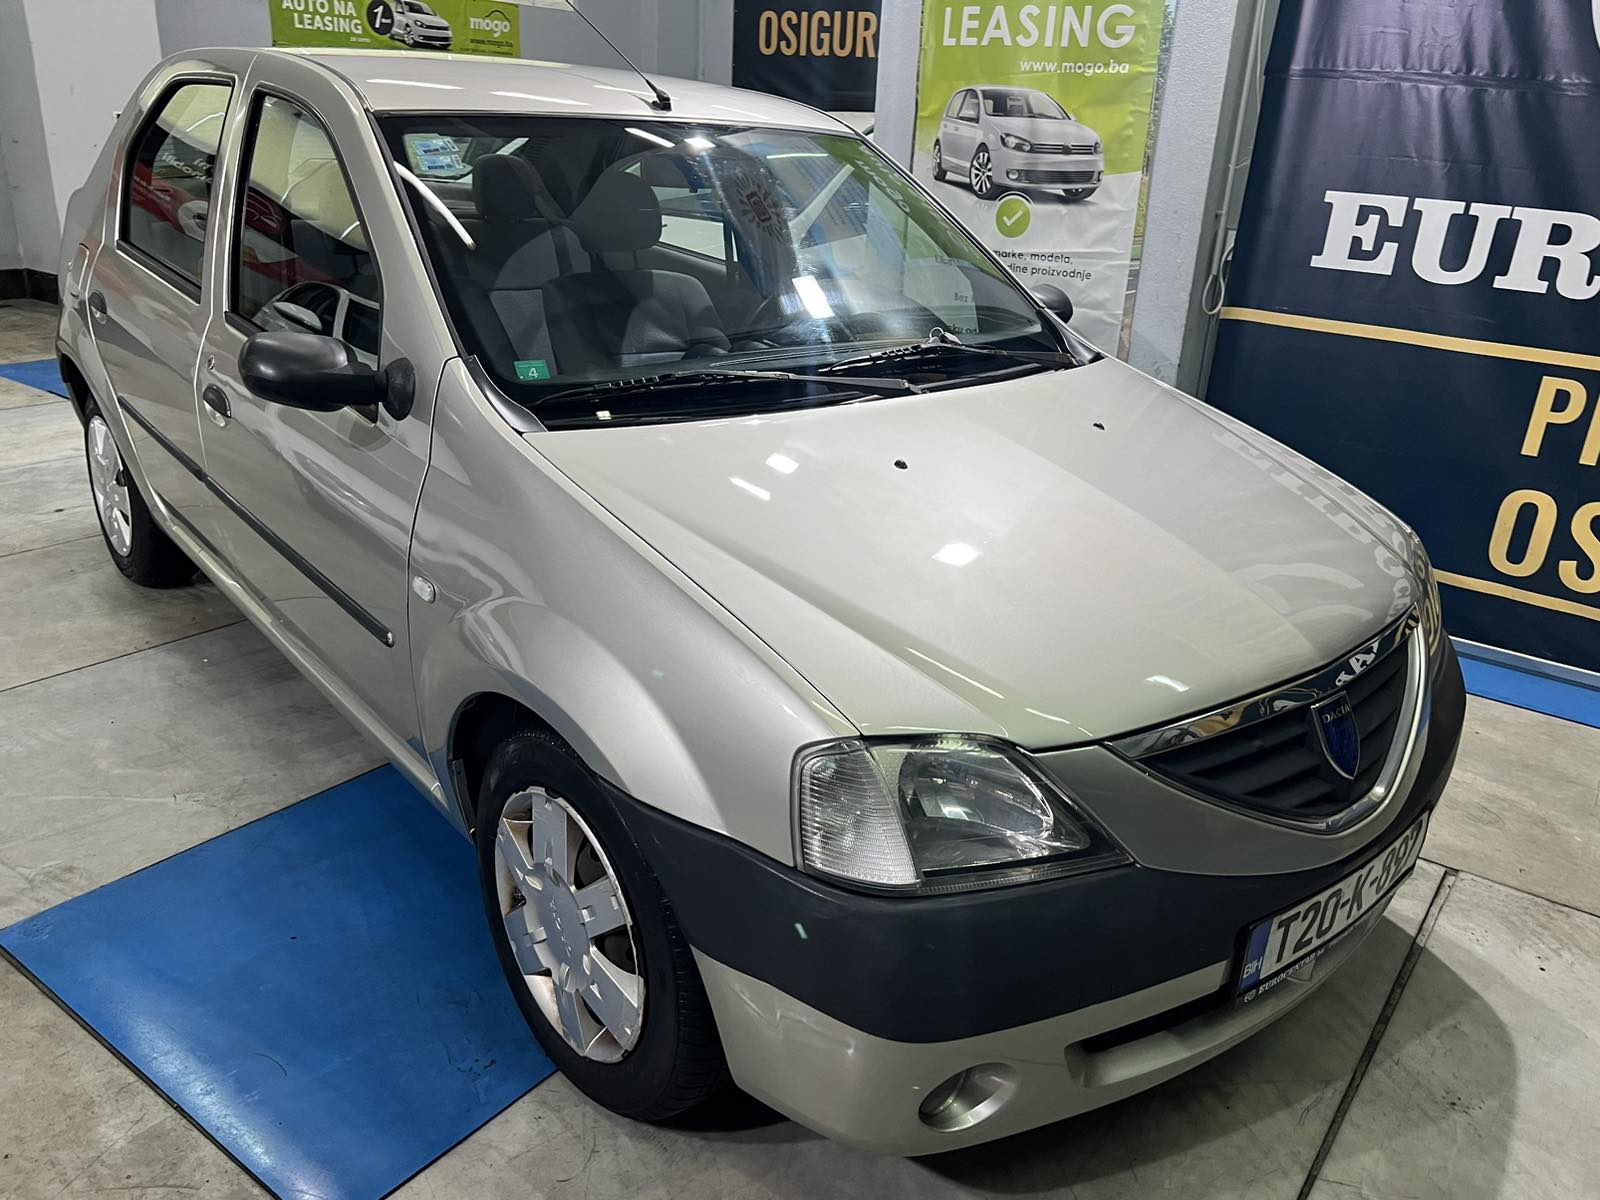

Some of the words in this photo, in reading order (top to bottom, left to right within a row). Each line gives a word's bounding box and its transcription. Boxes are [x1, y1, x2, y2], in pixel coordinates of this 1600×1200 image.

[334, 0, 357, 17] NA
[293, 13, 363, 34] LEASING
[470, 17, 510, 37] mogo
[759, 10, 878, 57] OSIGUR
[943, 4, 1136, 48] LEASING
[1019, 60, 1130, 76] www.mogo.ba
[1310, 189, 1600, 300] EUR
[1030, 252, 1073, 265] modela,
[1007, 263, 1028, 273] dine
[1031, 266, 1092, 281] proizvodnje
[528, 367, 539, 378] 4
[1488, 489, 1600, 594] OS
[1322, 703, 1350, 723] DACIA
[1243, 957, 1263, 979] BIH
